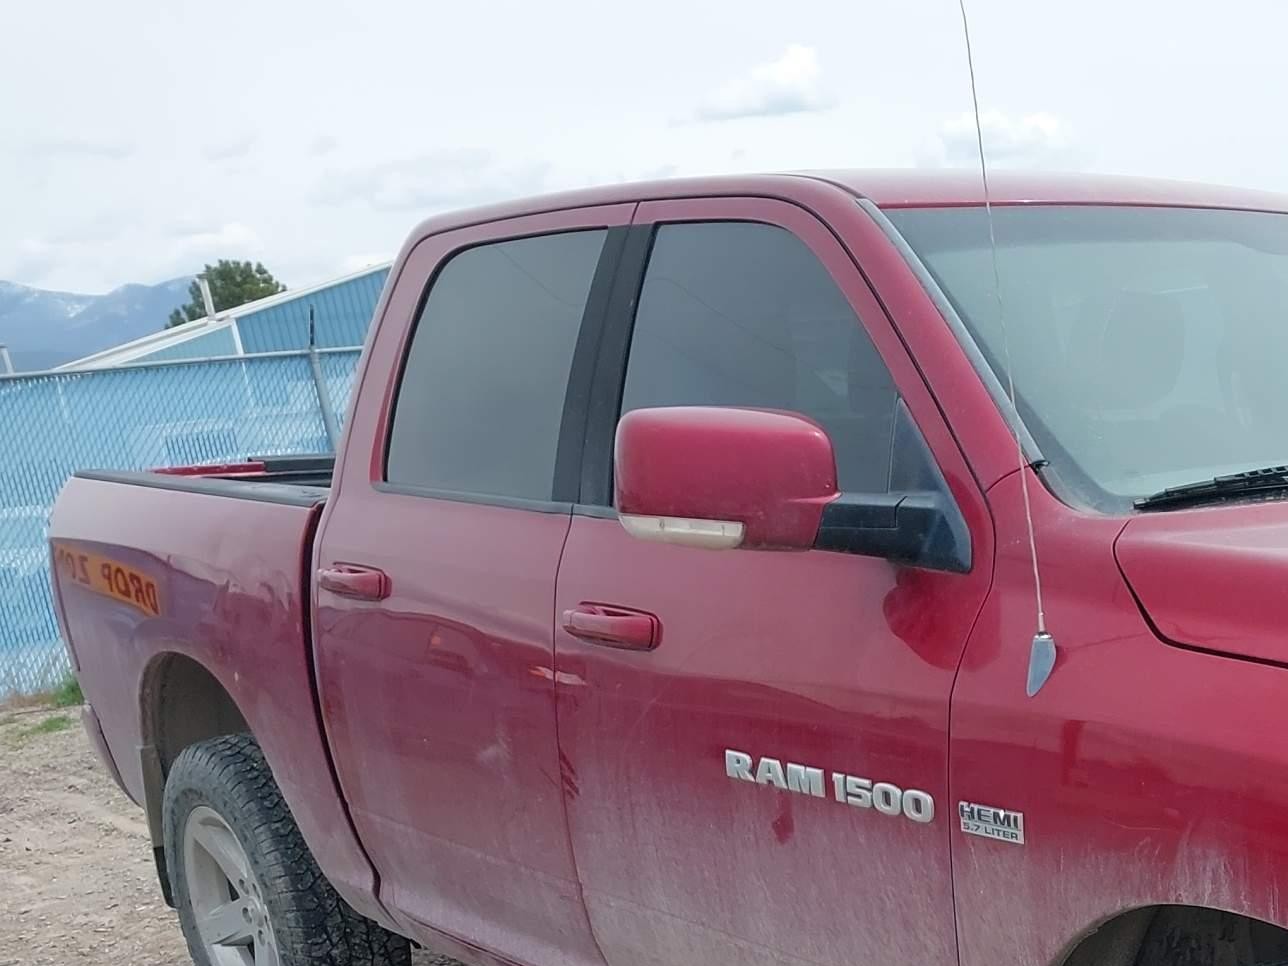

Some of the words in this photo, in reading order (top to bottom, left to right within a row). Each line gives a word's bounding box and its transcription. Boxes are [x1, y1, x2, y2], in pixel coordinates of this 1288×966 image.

[725, 749, 826, 798] RAM
[832, 772, 935, 823] 1500
[959, 803, 1019, 829] HEMI
[962, 821, 980, 832] 5.7
[984, 825, 1019, 841] LITER
